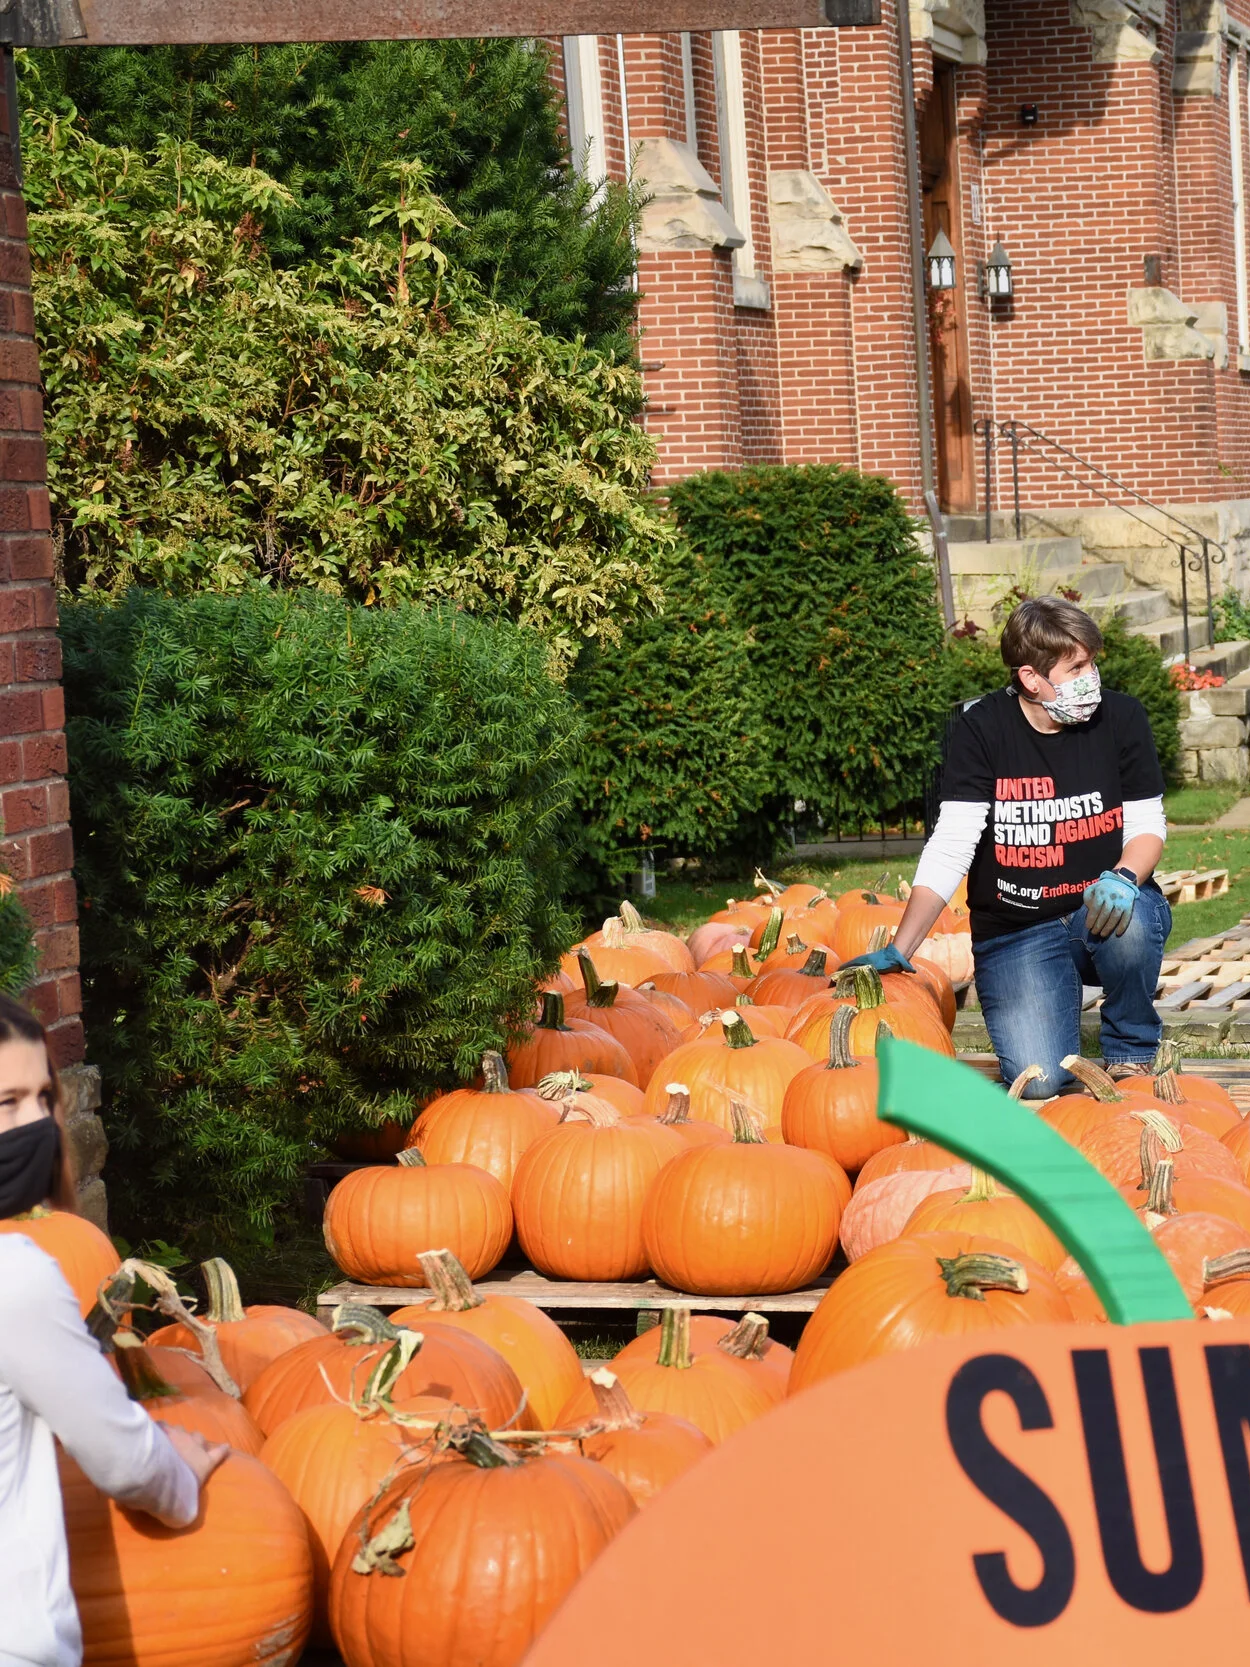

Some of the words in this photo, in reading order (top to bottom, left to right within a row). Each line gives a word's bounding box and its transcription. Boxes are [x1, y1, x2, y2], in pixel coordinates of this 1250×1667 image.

[996, 777, 1055, 800] UNITED
[994, 791, 1103, 822] METHODISTS
[994, 823, 1051, 845] STAND
[1055, 807, 1123, 844] AGAINST
[995, 845, 1064, 867] RACISM
